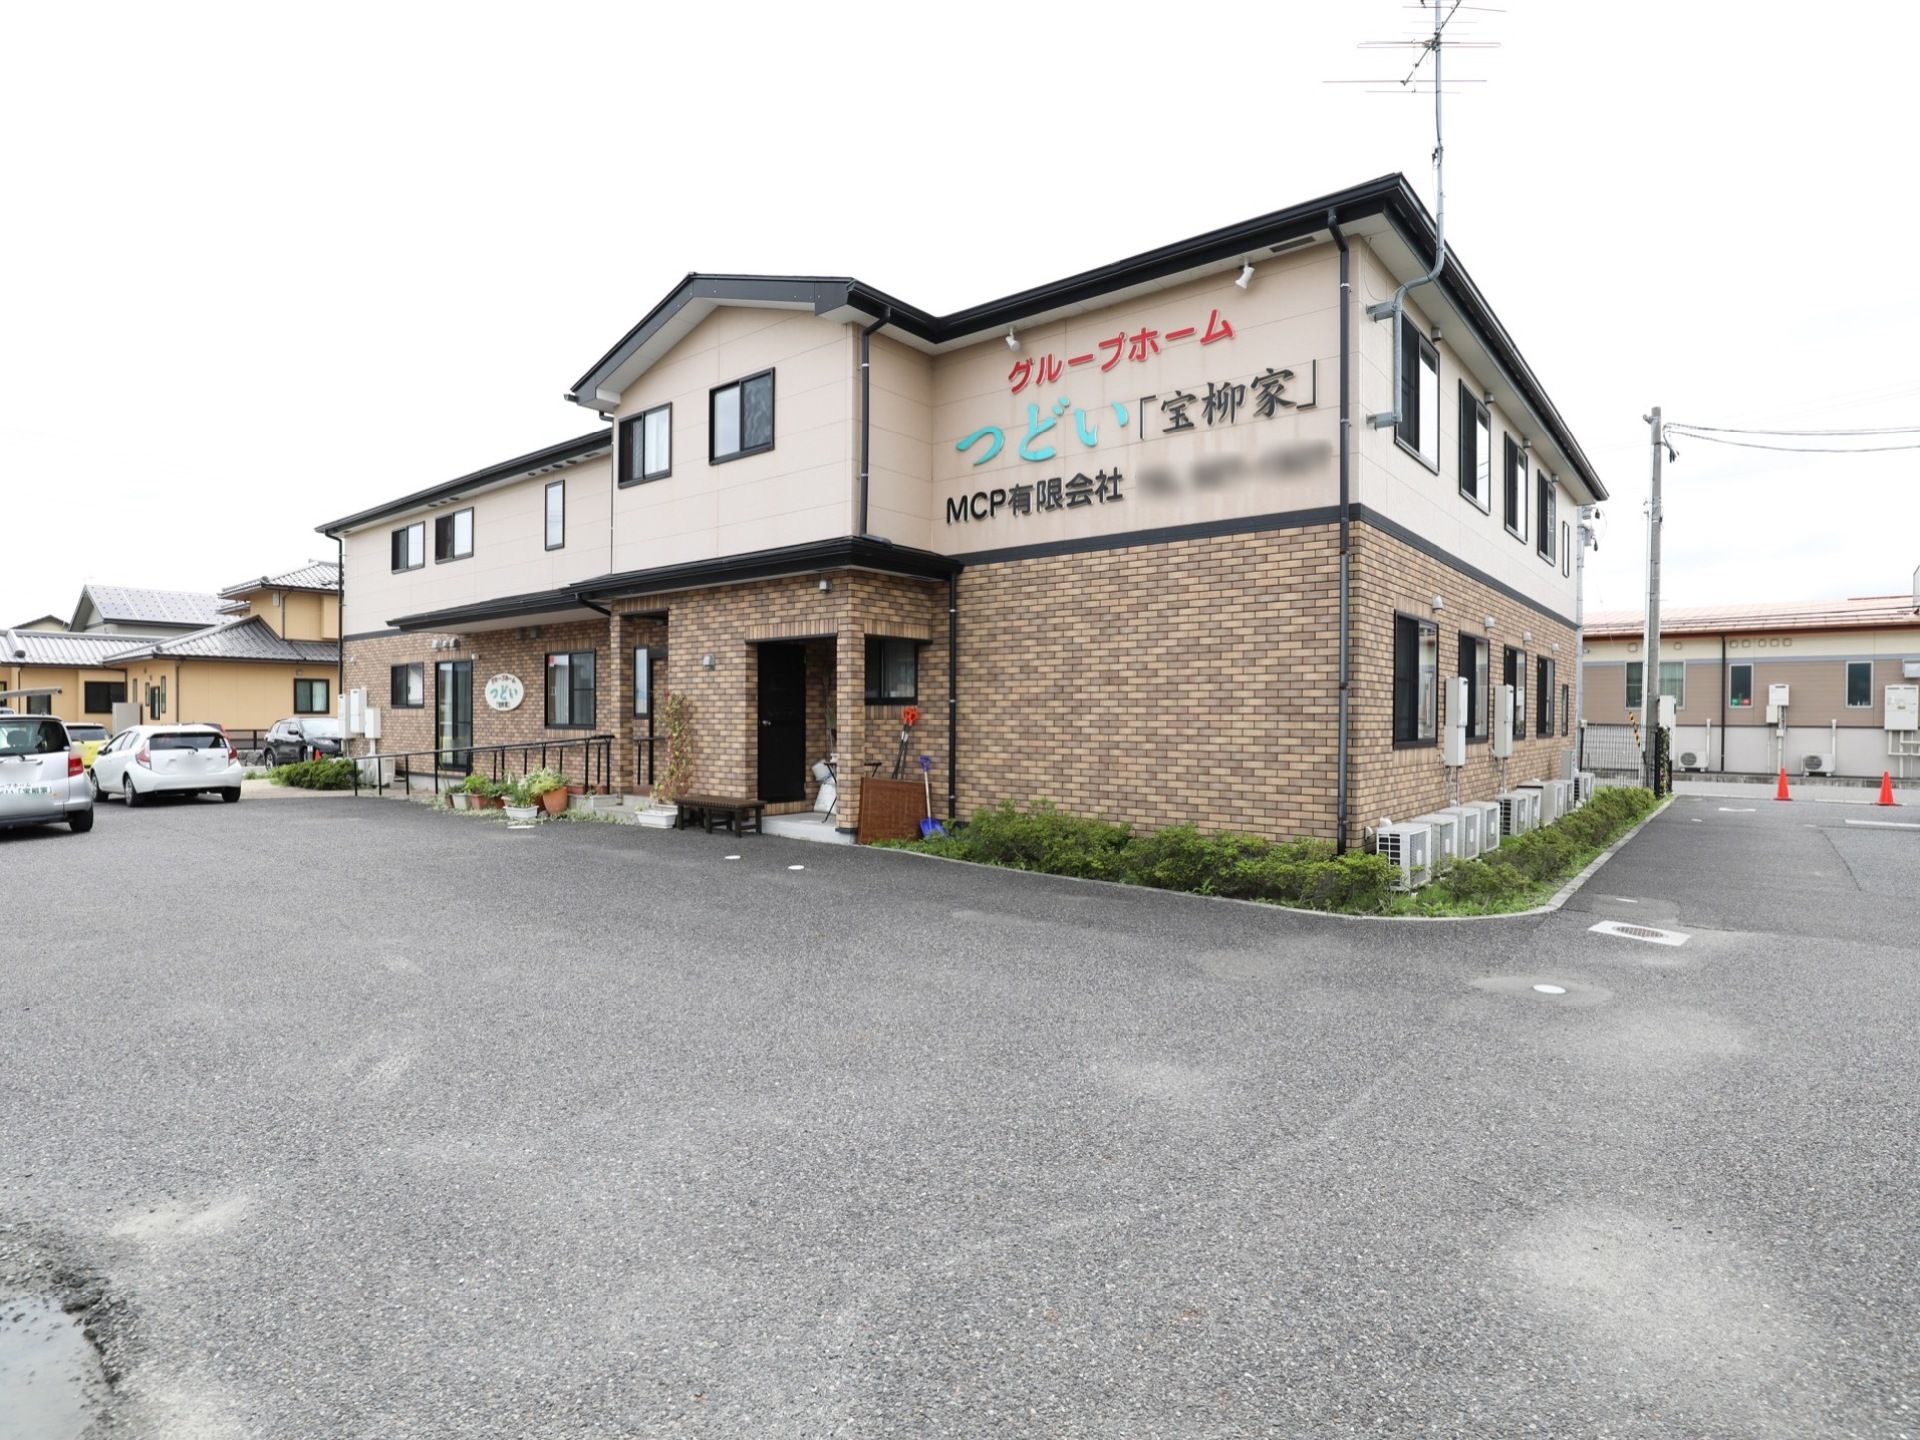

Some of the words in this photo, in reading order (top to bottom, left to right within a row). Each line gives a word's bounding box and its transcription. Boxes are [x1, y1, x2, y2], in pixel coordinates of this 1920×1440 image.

[1008, 309, 1235, 394] グループホーム
[946, 466, 1124, 525] MCP有限会社
